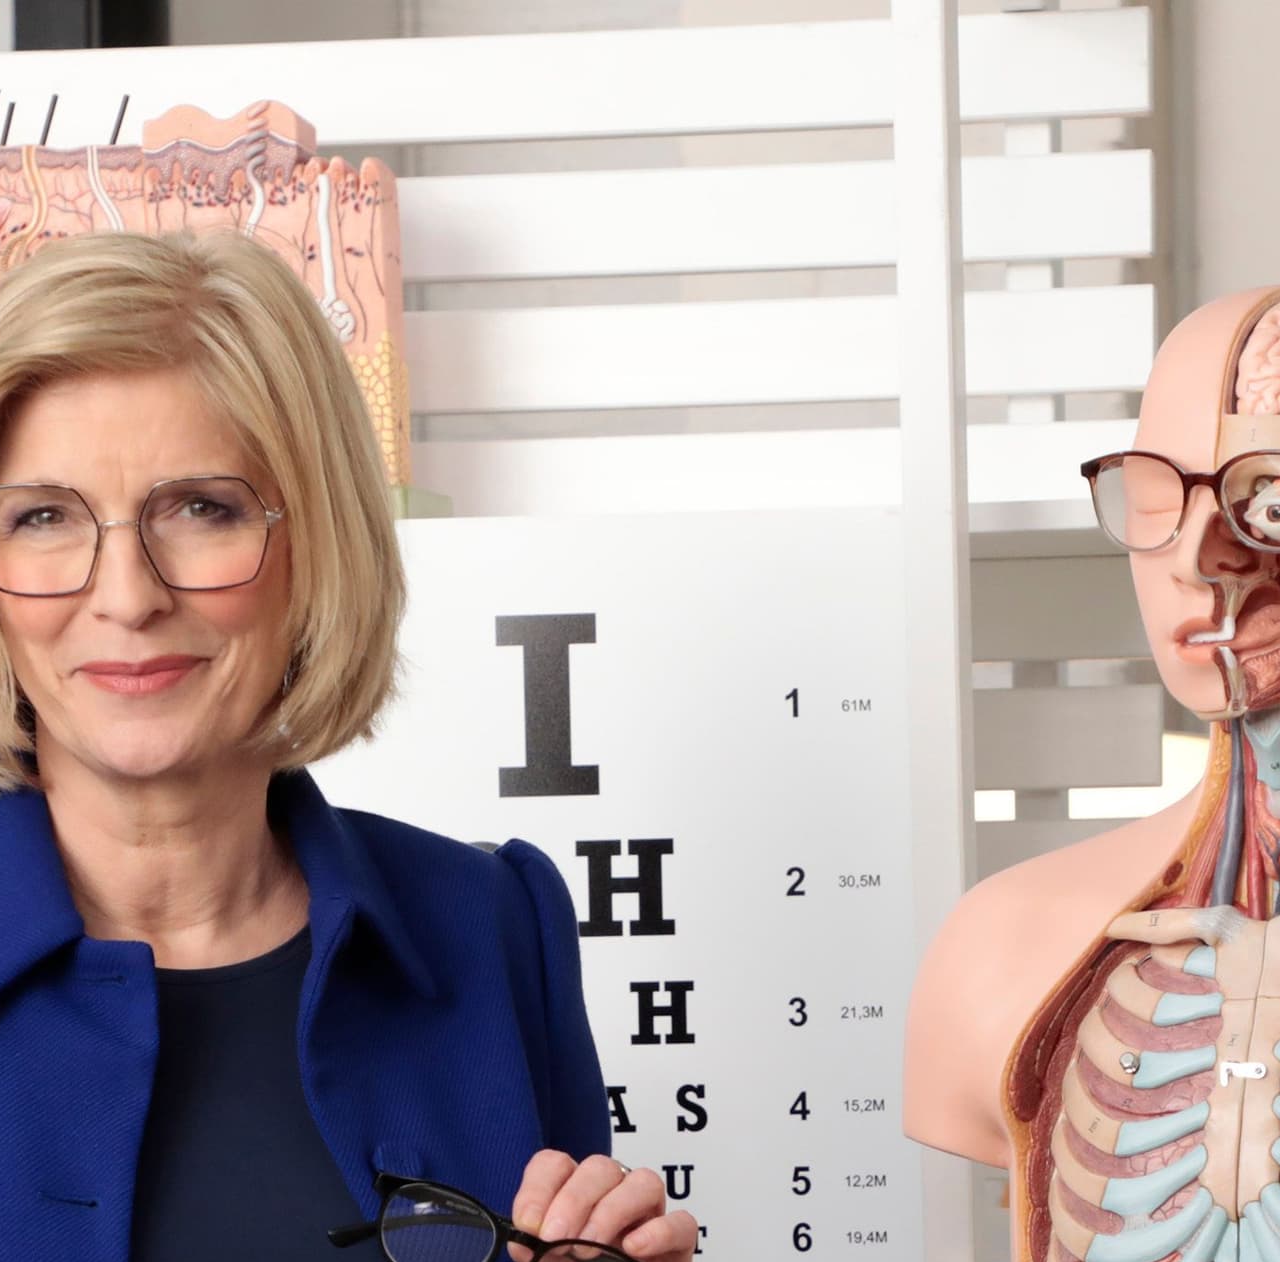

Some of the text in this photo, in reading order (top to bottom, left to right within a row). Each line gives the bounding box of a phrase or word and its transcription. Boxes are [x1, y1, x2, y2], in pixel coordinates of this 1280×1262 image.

[495, 612, 872, 798] I 1 61M
[574, 837, 881, 938] H 2 30,5M
[629, 980, 884, 1046] H 3 21,3M
[675, 1083, 709, 1133] S
[789, 1091, 811, 1121] 4
[844, 1098, 885, 1113] 15,2M
[661, 1163, 887, 1201] U 5 12,2M
[792, 1222, 813, 1253] 6
[847, 1230, 888, 1245] 19,4M
